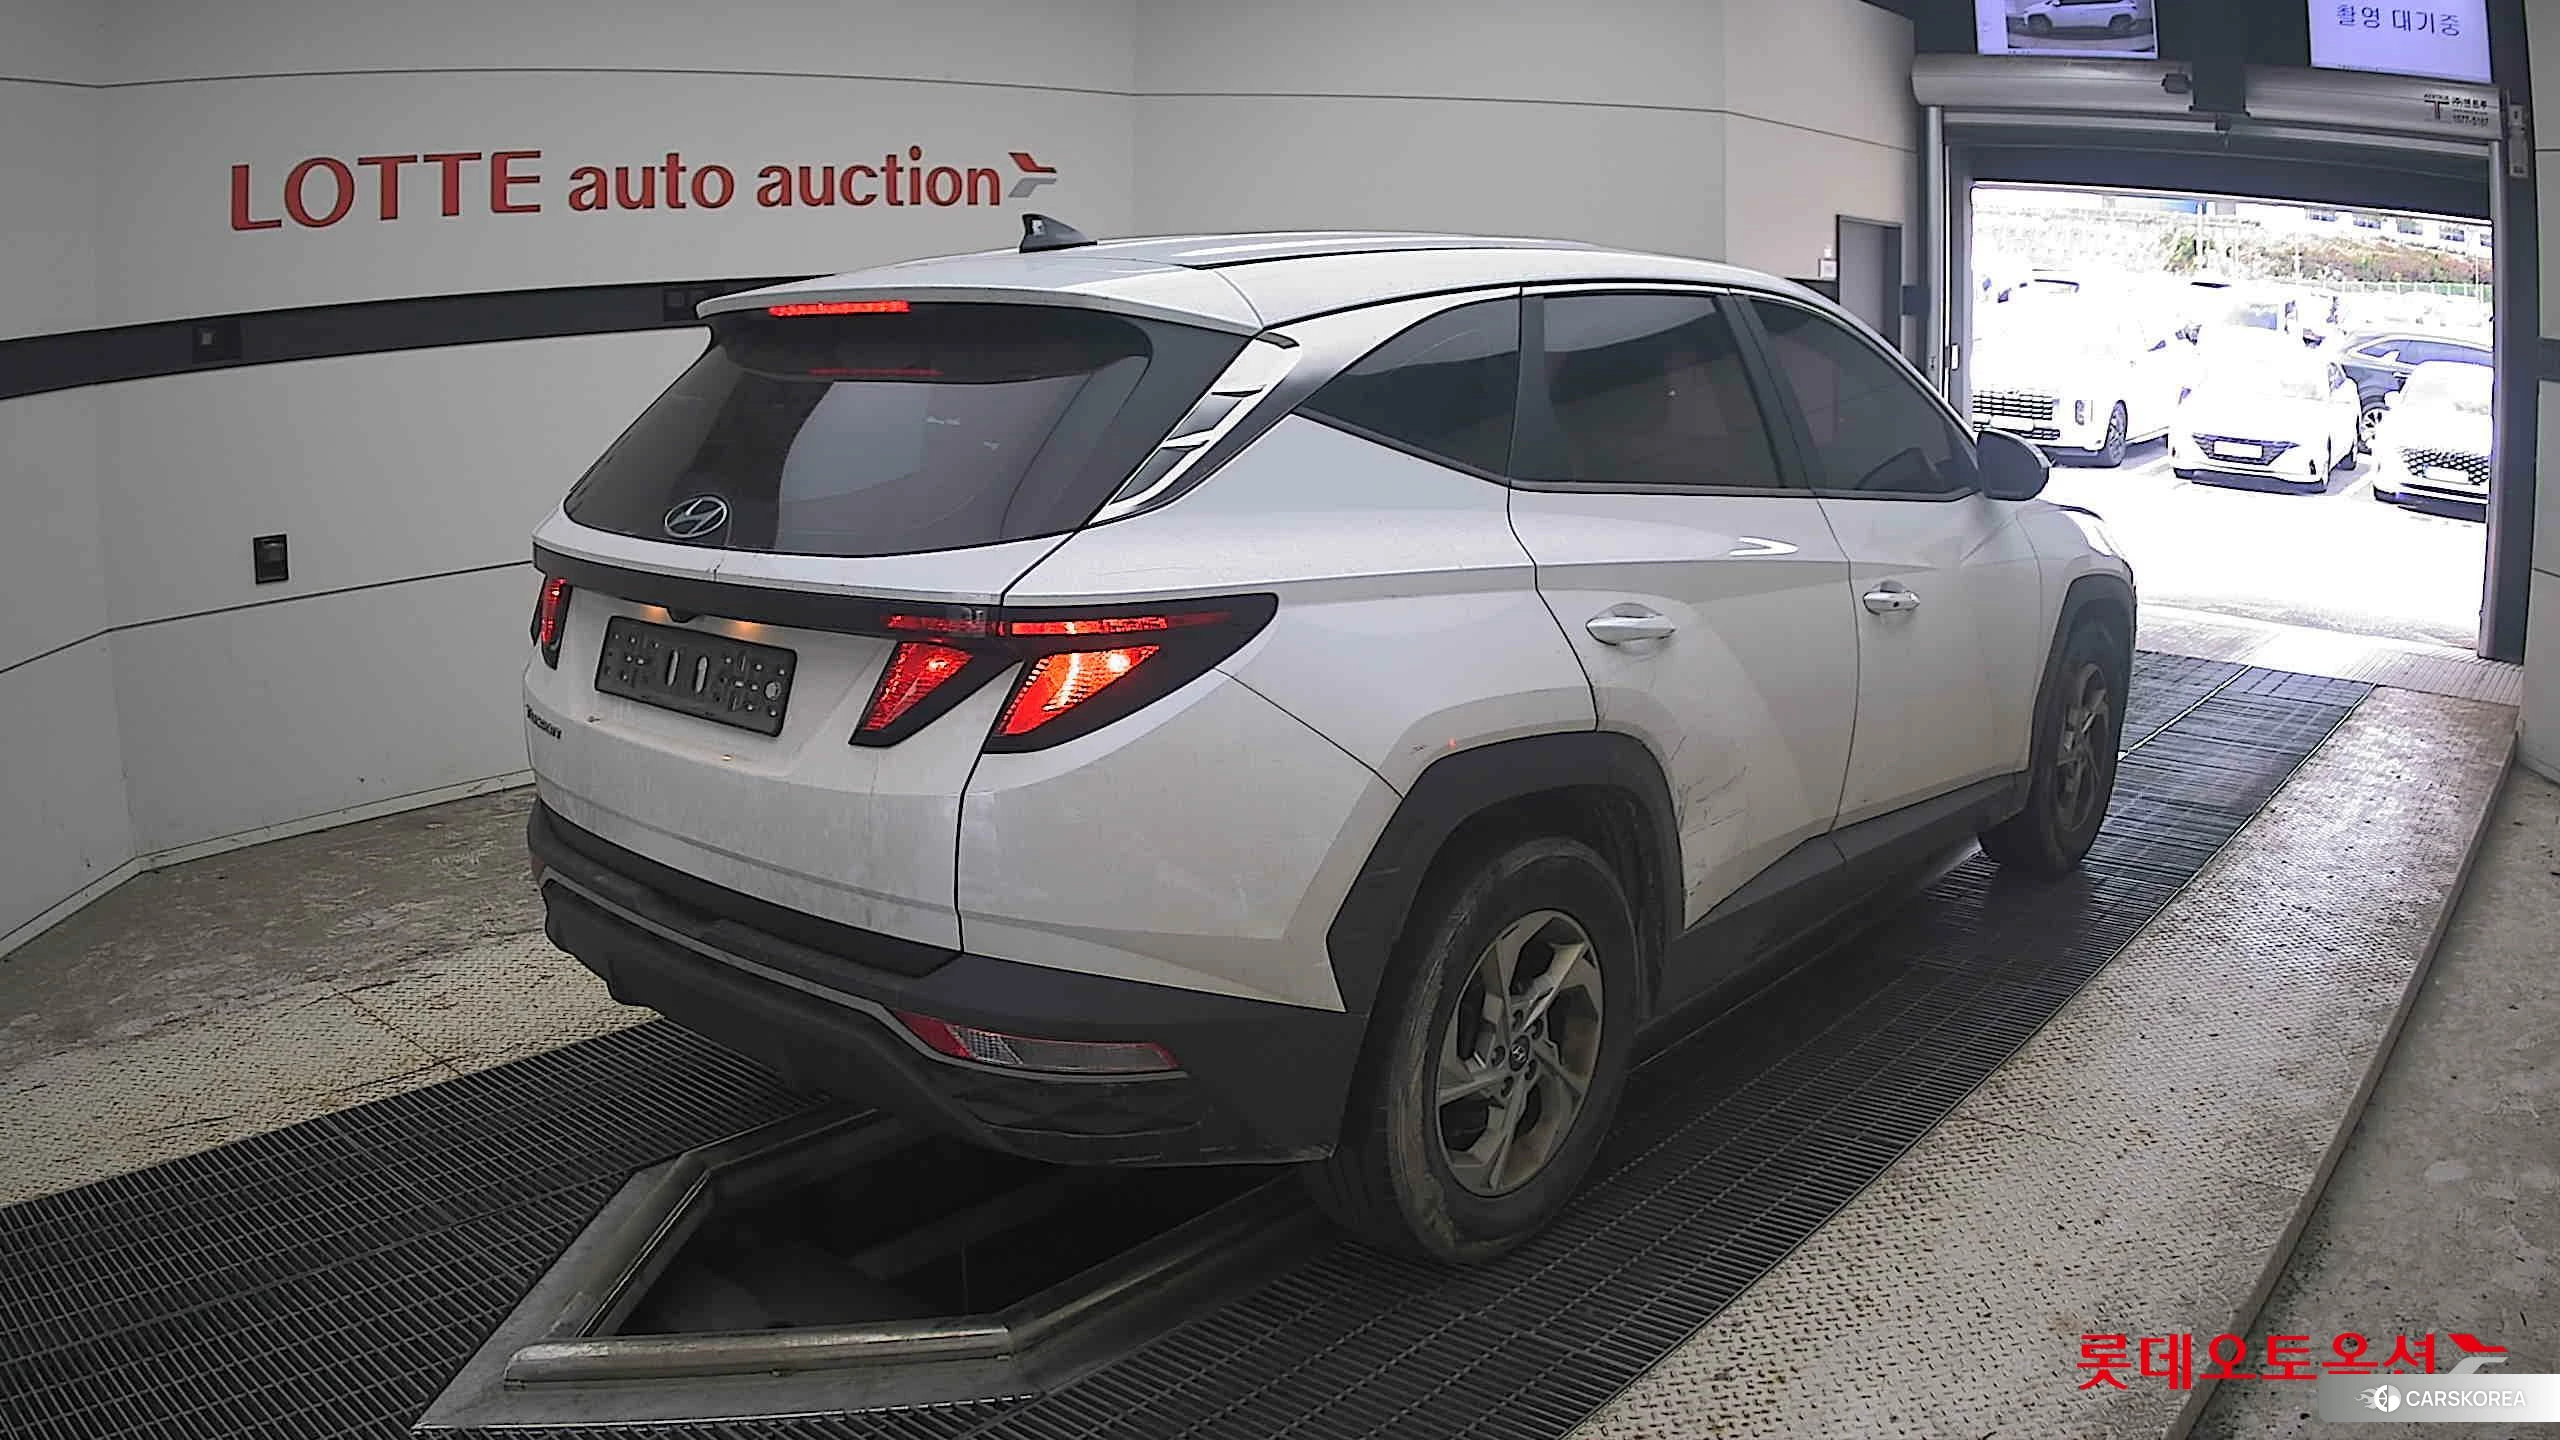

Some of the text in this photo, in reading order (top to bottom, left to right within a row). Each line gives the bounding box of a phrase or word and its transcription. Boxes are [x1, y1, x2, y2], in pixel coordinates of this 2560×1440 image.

[2337, 4, 2461, 37] 촬영 대기중
[230, 145, 1002, 232] LOTTE auto auction
